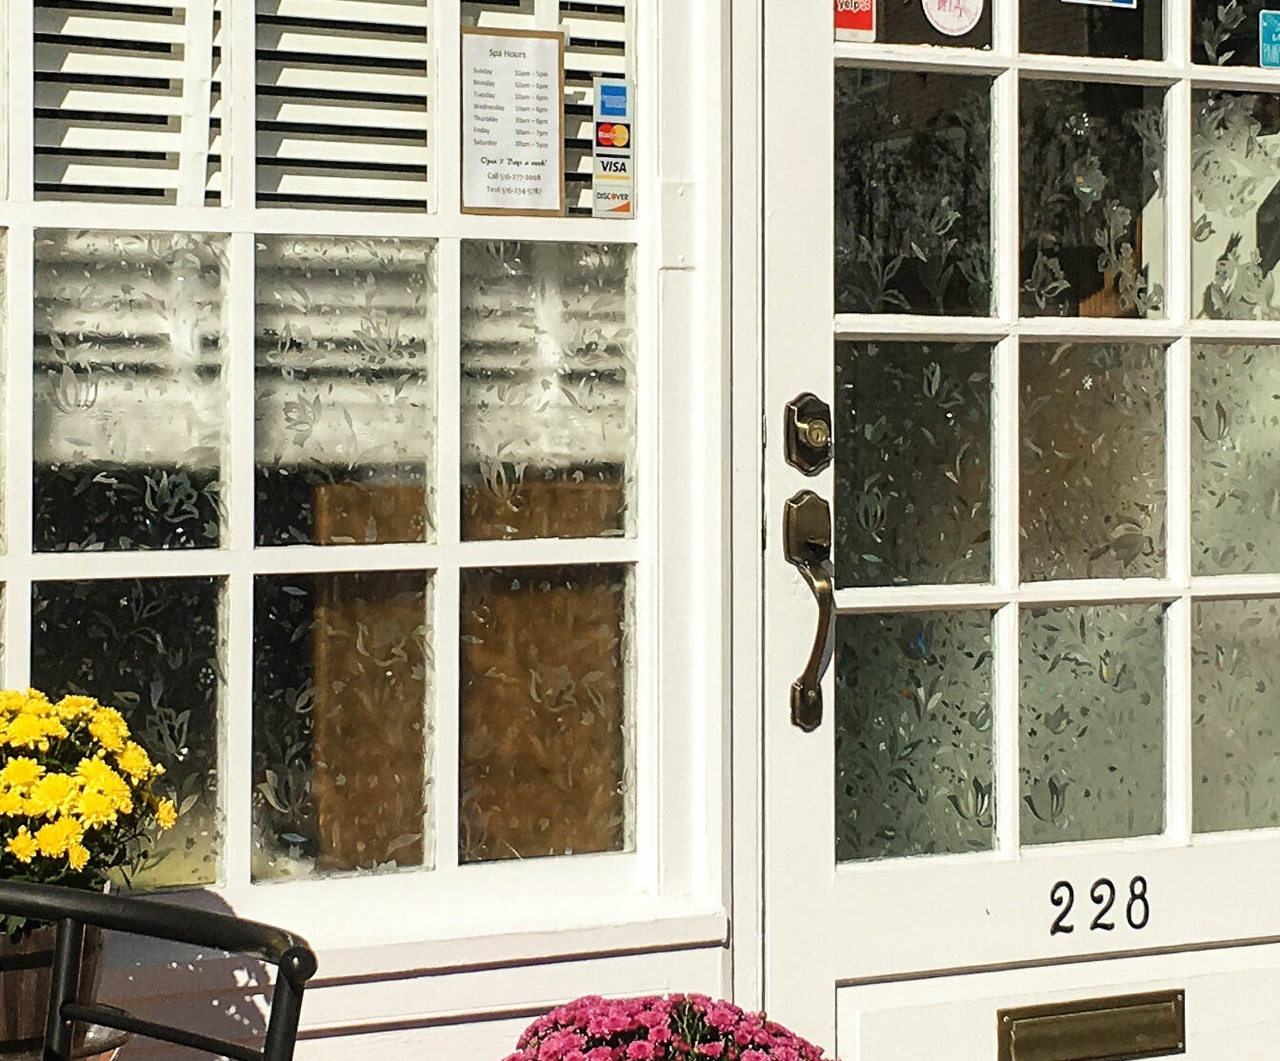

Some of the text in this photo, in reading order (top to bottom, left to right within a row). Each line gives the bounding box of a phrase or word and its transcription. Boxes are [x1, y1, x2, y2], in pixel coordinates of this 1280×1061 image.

[488, 48, 527, 59] Spa Hours
[600, 160, 627, 173] VISA
[487, 171, 499, 180] Call
[486, 185, 500, 194] Text
[596, 191, 629, 201] DISCOVER
[1049, 874, 1150, 936] 228
